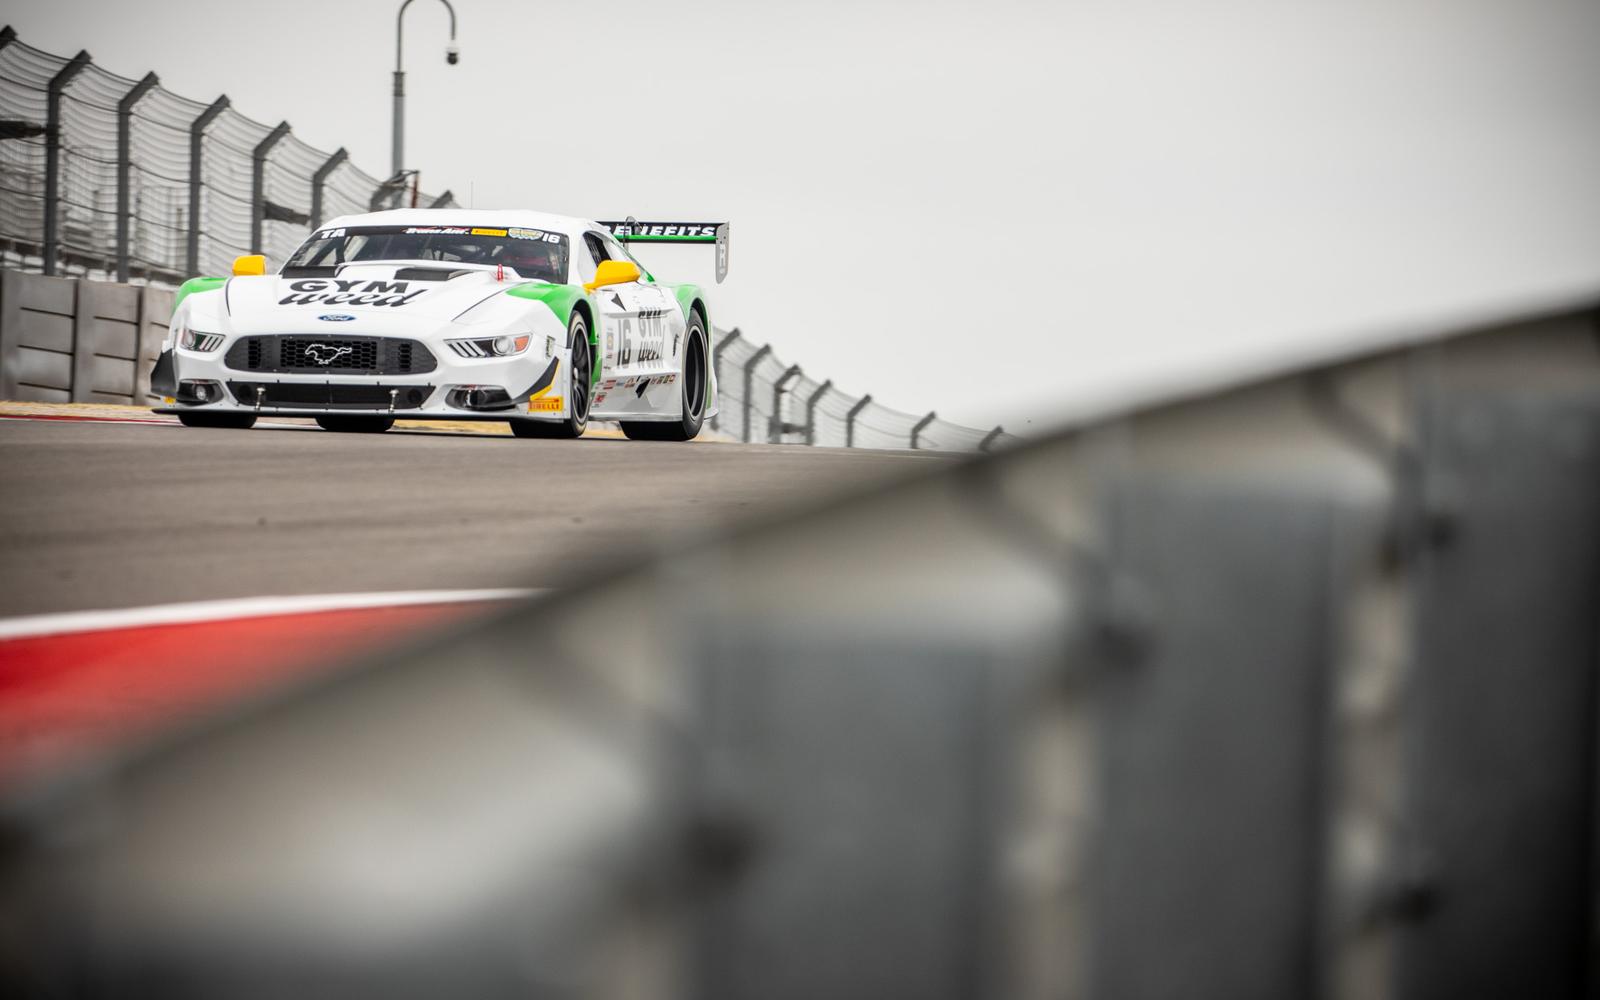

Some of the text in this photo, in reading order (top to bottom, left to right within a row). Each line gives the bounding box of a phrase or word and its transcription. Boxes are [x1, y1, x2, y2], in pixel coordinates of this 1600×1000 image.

[321, 228, 346, 239] TA
[542, 233, 561, 244] 16
[289, 280, 409, 293] GYM
[278, 289, 429, 307] weed
[638, 306, 662, 338] GYM
[617, 319, 632, 366] 16
